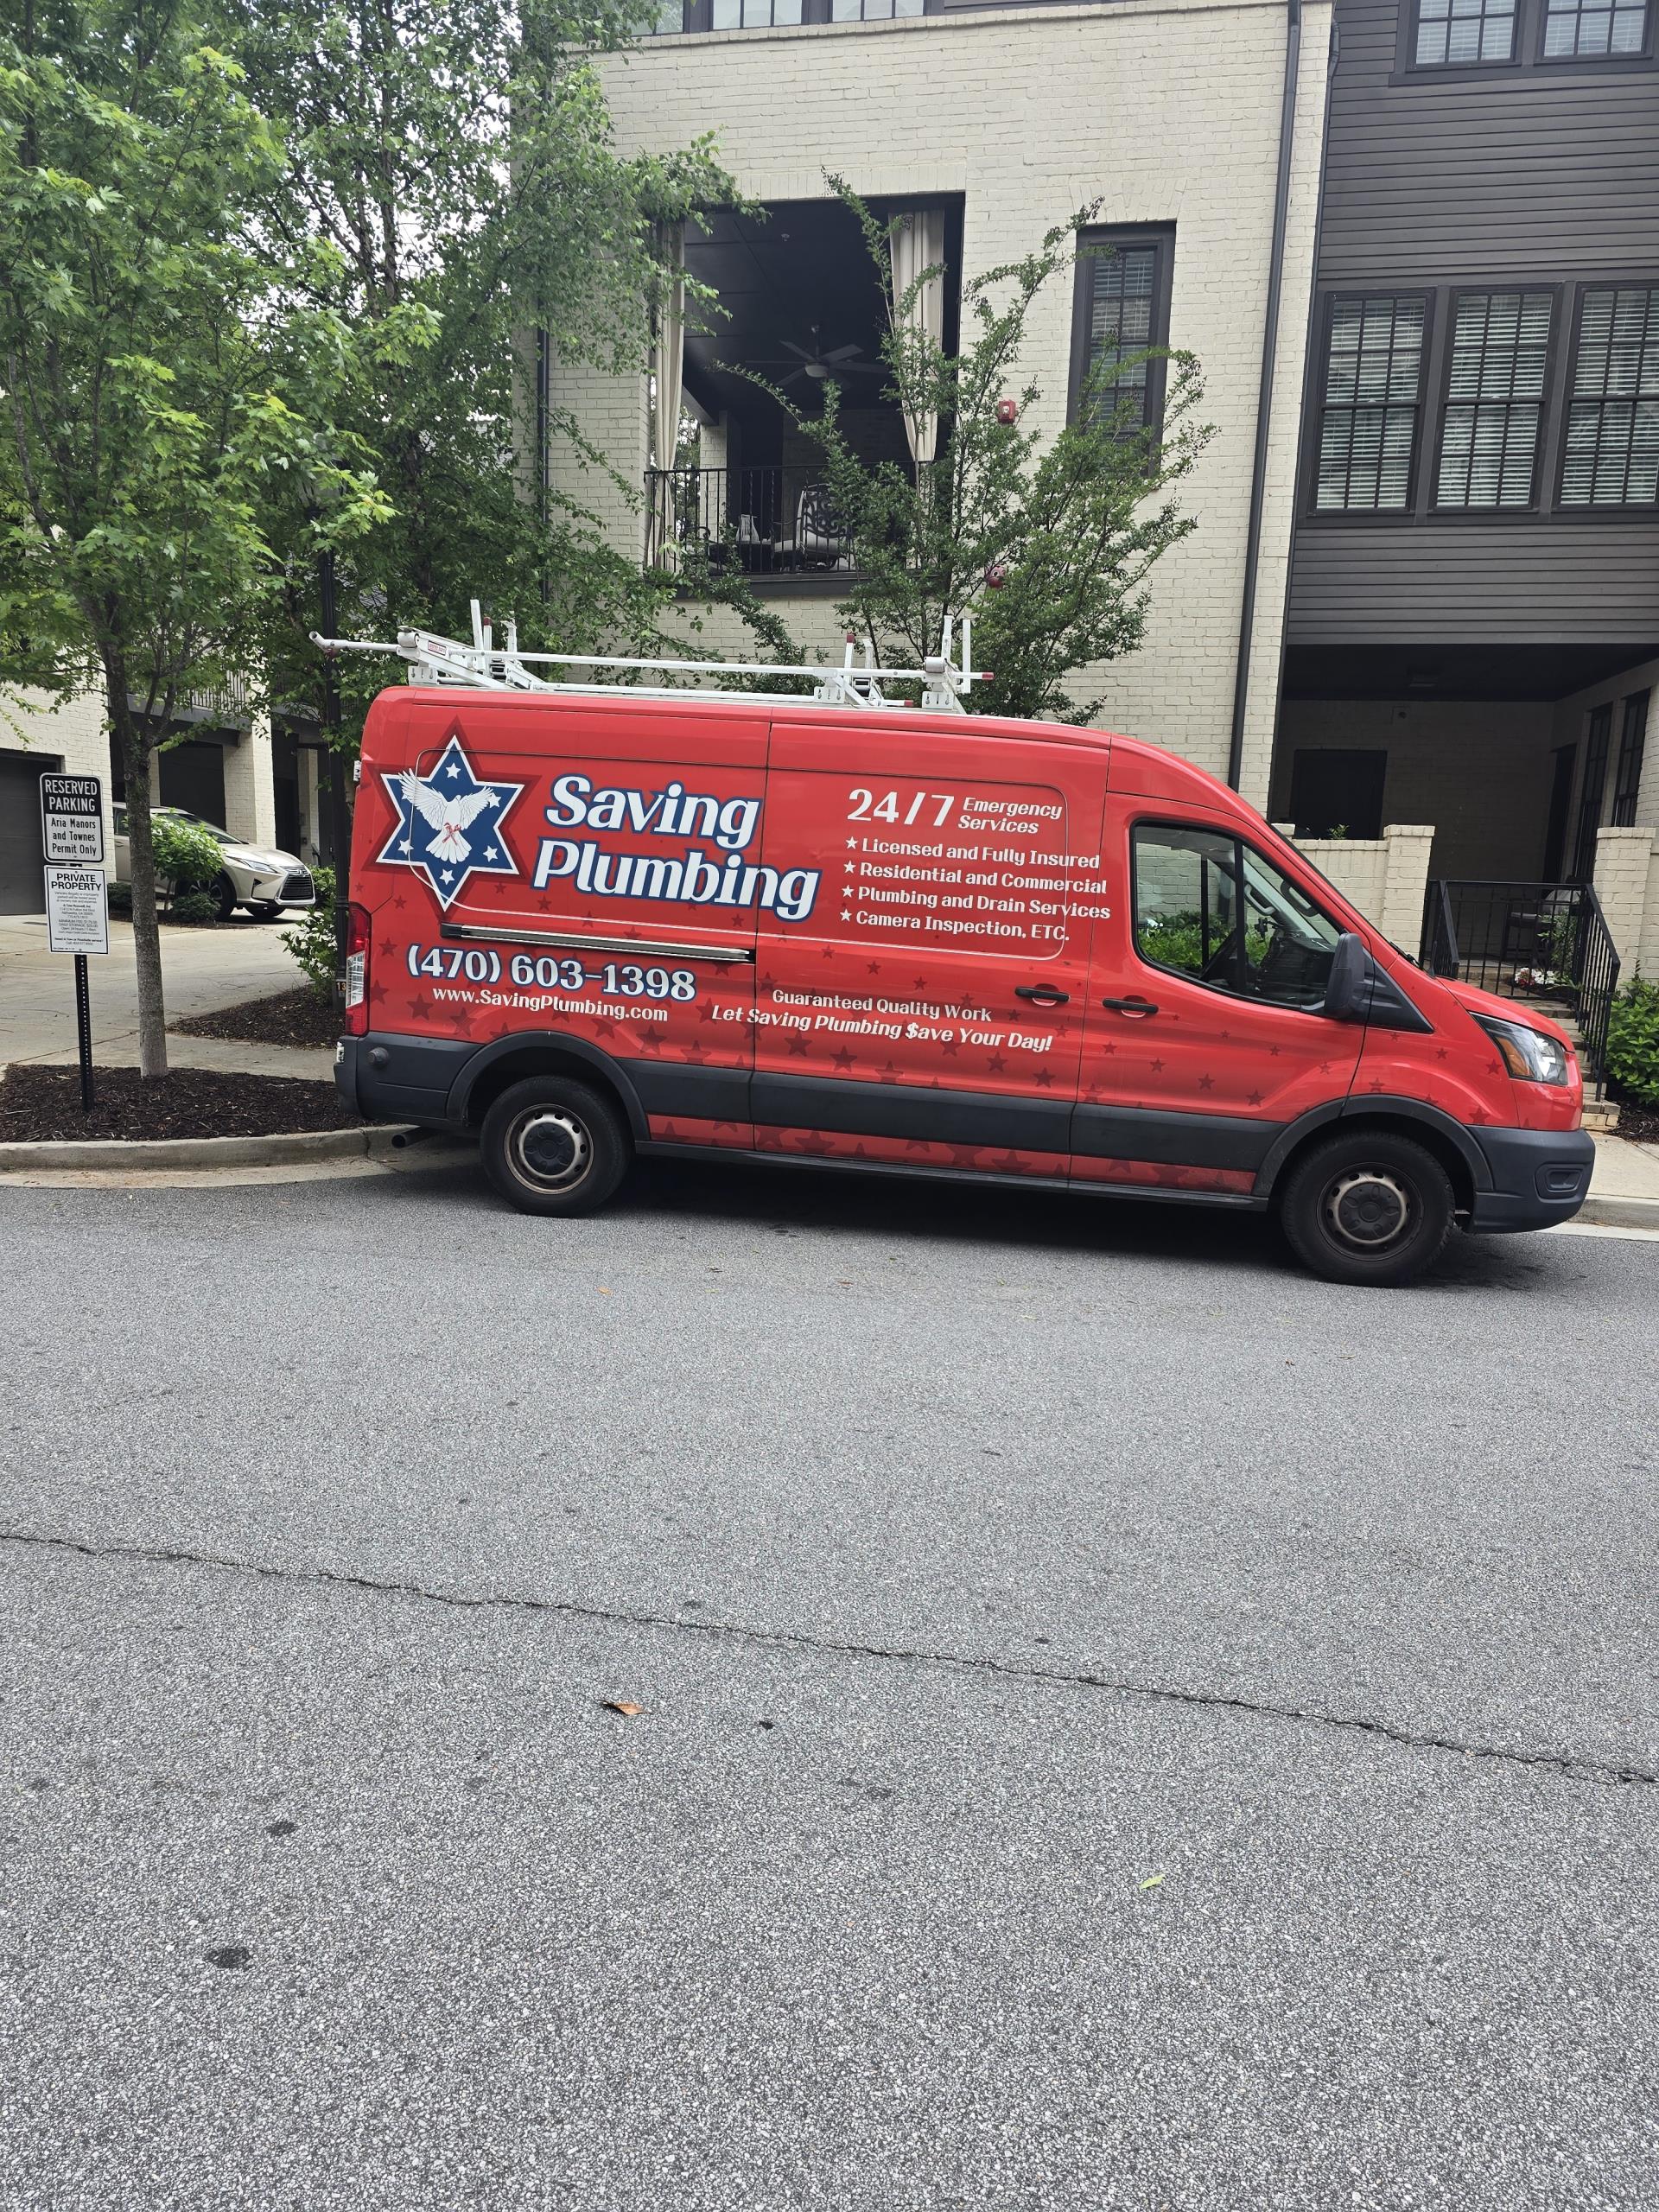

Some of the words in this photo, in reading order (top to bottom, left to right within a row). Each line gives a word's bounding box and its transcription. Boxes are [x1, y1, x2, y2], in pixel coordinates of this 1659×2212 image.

[45, 779, 97, 795] RESERVED
[49, 796, 96, 812] PARKING
[545, 774, 761, 850] Saving
[847, 788, 955, 827] 24/7
[963, 797, 1063, 820] Emergency
[51, 817, 67, 828] Aria
[70, 817, 96, 829] Manors
[53, 831, 66, 840] and
[69, 831, 96, 842] Townes
[958, 815, 1039, 834] Services
[52, 842, 77, 854] Permit
[79, 844, 97, 856] Only
[861, 837, 943, 858] Licensed
[946, 844, 978, 861] and
[982, 847, 1025, 867] Fully
[1028, 850, 1100, 869] Insured
[51, 881, 102, 891] PROPERTY
[56, 873, 96, 882] PRIVATE
[533, 839, 820, 920] Plumbing
[860, 861, 962, 883] Residential
[965, 870, 997, 887] and
[1001, 873, 1107, 894] Commercial
[858, 886, 938, 908] Plumbing
[941, 894, 973, 910] and
[976, 896, 1026, 913] Drain
[1028, 899, 1111, 919] Services
[855, 910, 921, 930] Camera
[925, 916, 1027, 938] Inspection,
[1031, 925, 1070, 941] ETC.
[407, 944, 501, 982] (470)
[511, 954, 697, 1001] 603-1398
[433, 988, 668, 1022] www.SavingPlumbing.com
[772, 989, 873, 1012] Guaranteed
[876, 999, 940, 1020] Quality
[944, 1004, 992, 1023] Work
[711, 1004, 744, 1022] Let
[747, 1008, 811, 1032] Saving
[815, 1014, 902, 1039] Plumbing
[906, 1023, 953, 1043] $ave
[960, 1027, 1005, 1047] Your
[1007, 1033, 1053, 1052] Day!
